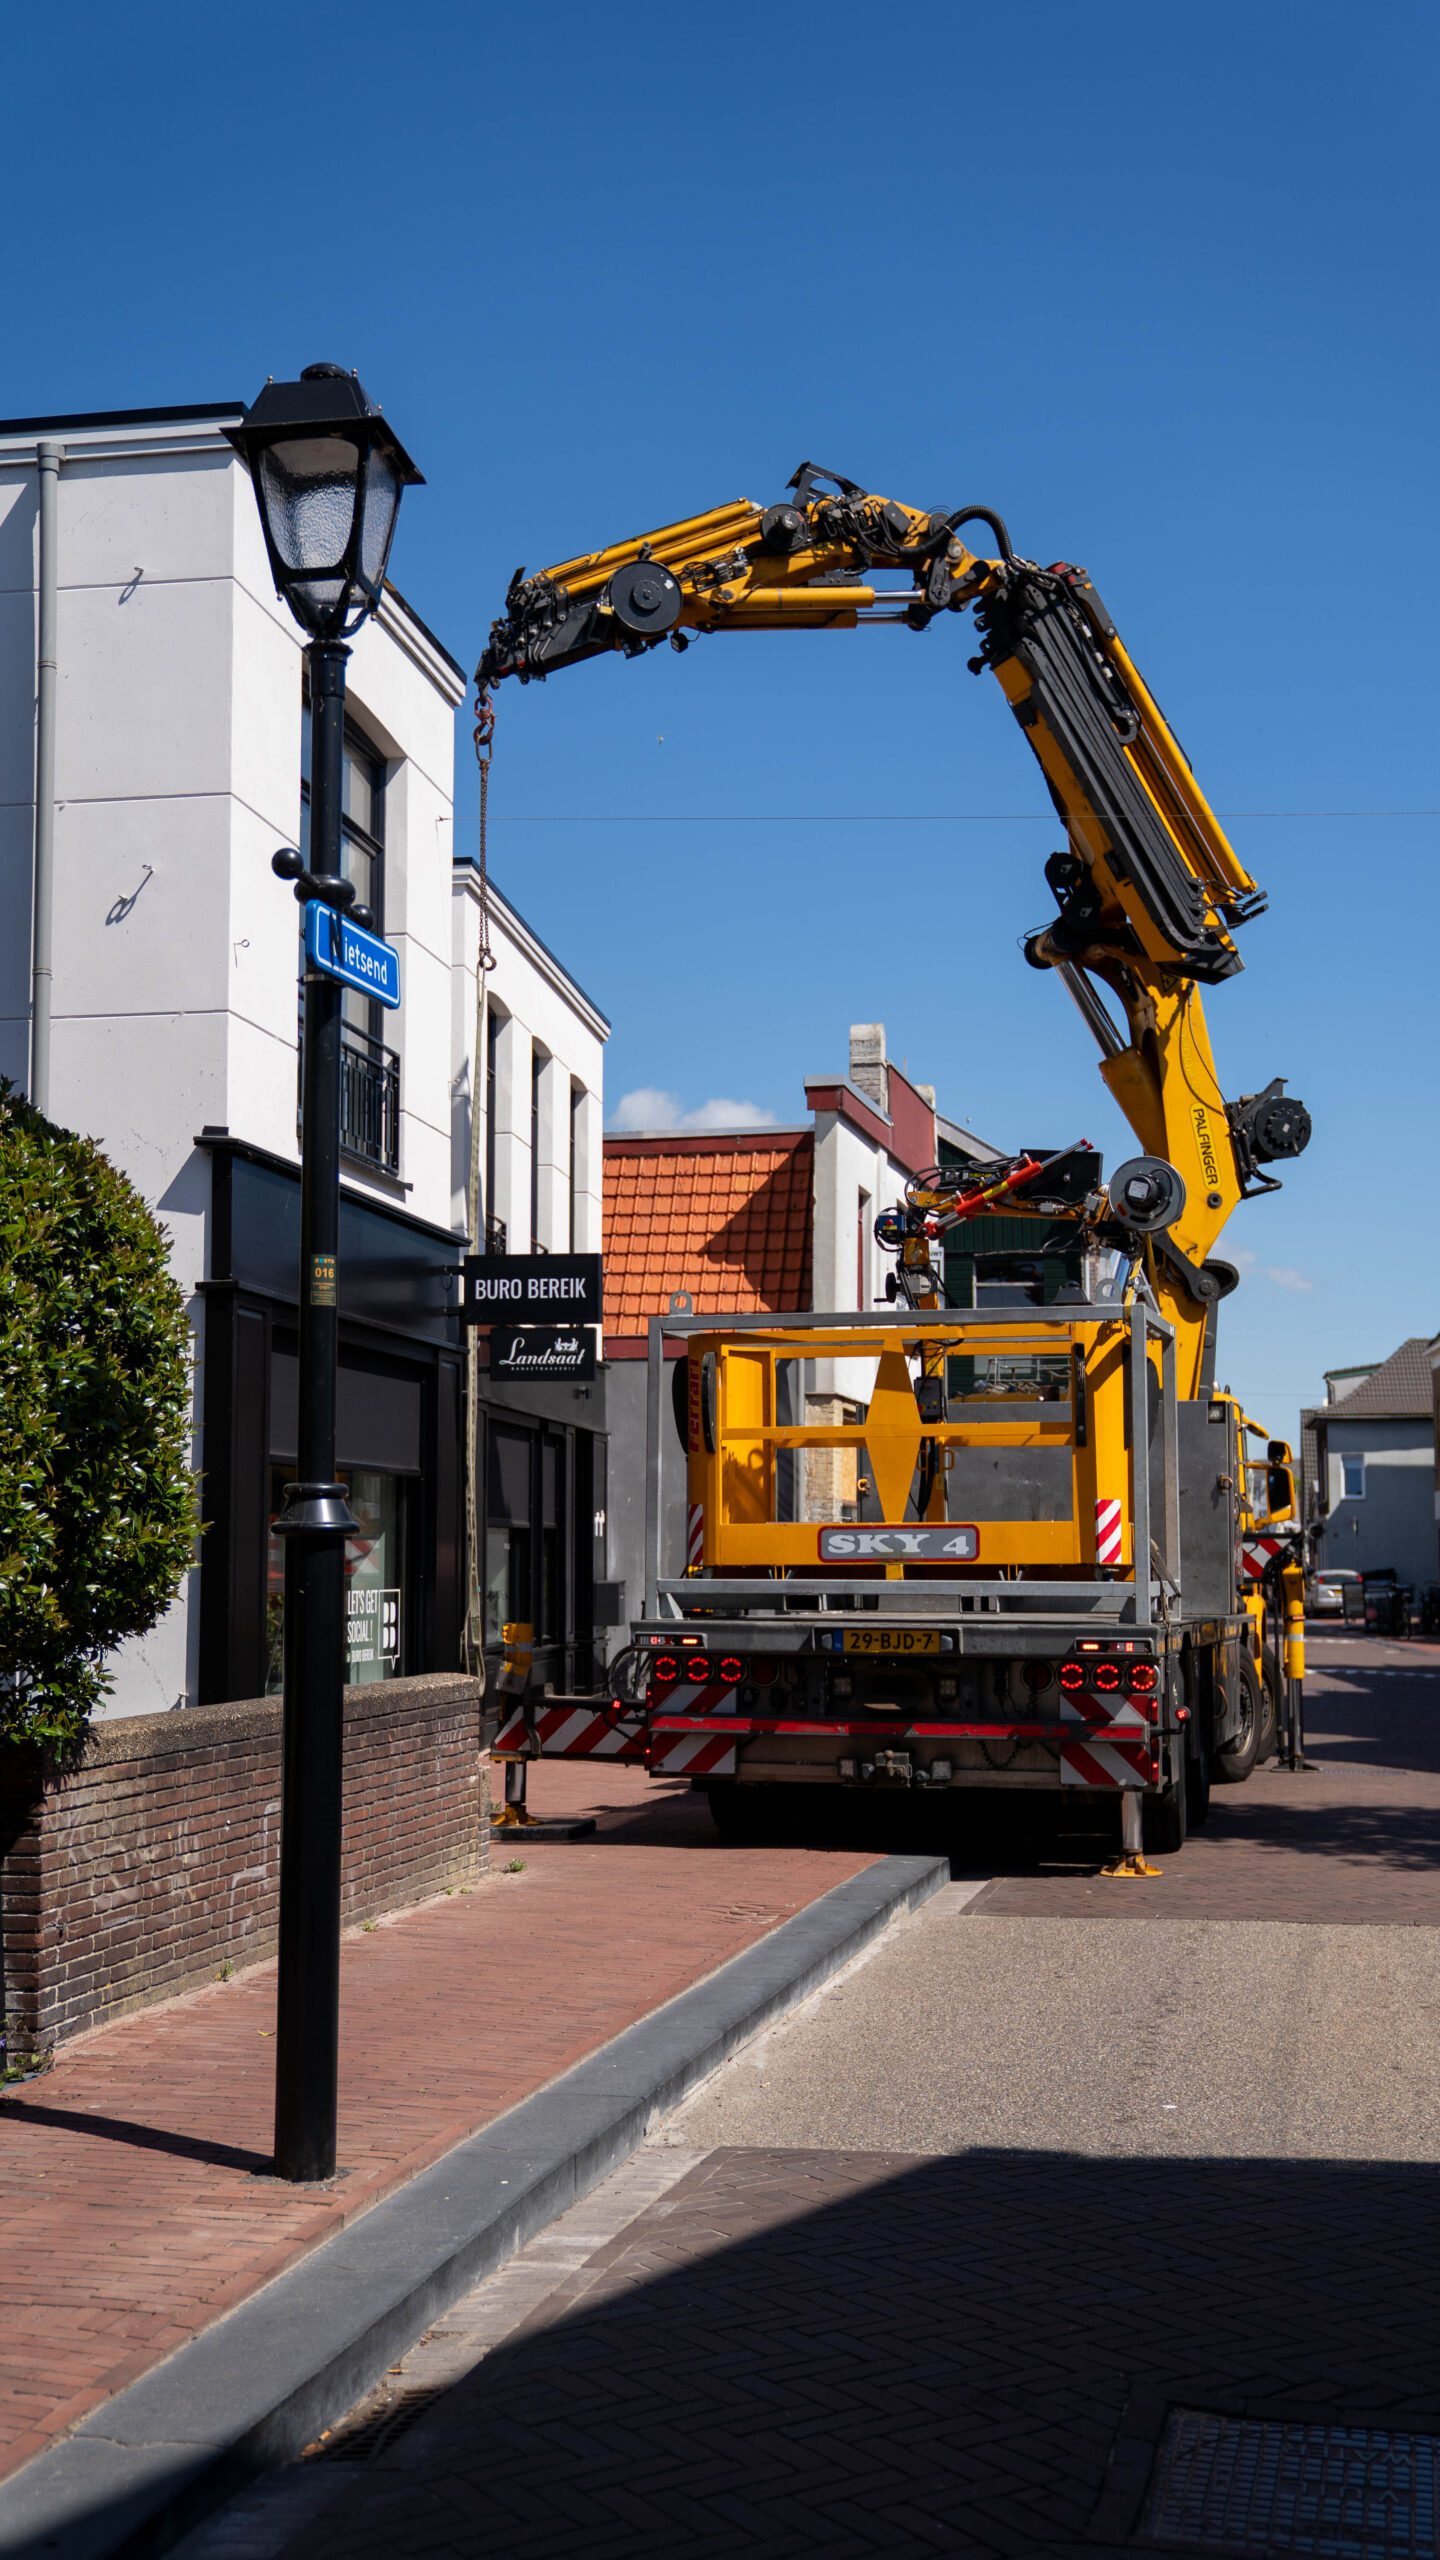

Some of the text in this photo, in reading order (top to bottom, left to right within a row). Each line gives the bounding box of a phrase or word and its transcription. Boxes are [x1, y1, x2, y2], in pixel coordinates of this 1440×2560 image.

[332, 933, 388, 985] ietsend
[1192, 1108, 1219, 1186] PALFINGER
[314, 1267, 335, 1279] 016
[475, 1277, 587, 1300] BURO BEREIK
[498, 1337, 586, 1366] Landsaat
[688, 1358, 700, 1454] Ferrari
[827, 1534, 970, 1555] SKY 4
[366, 1589, 378, 1614] GET
[850, 1632, 933, 1650] 29-BJD-7
[1282, 2442, 1414, 2467] WATER
